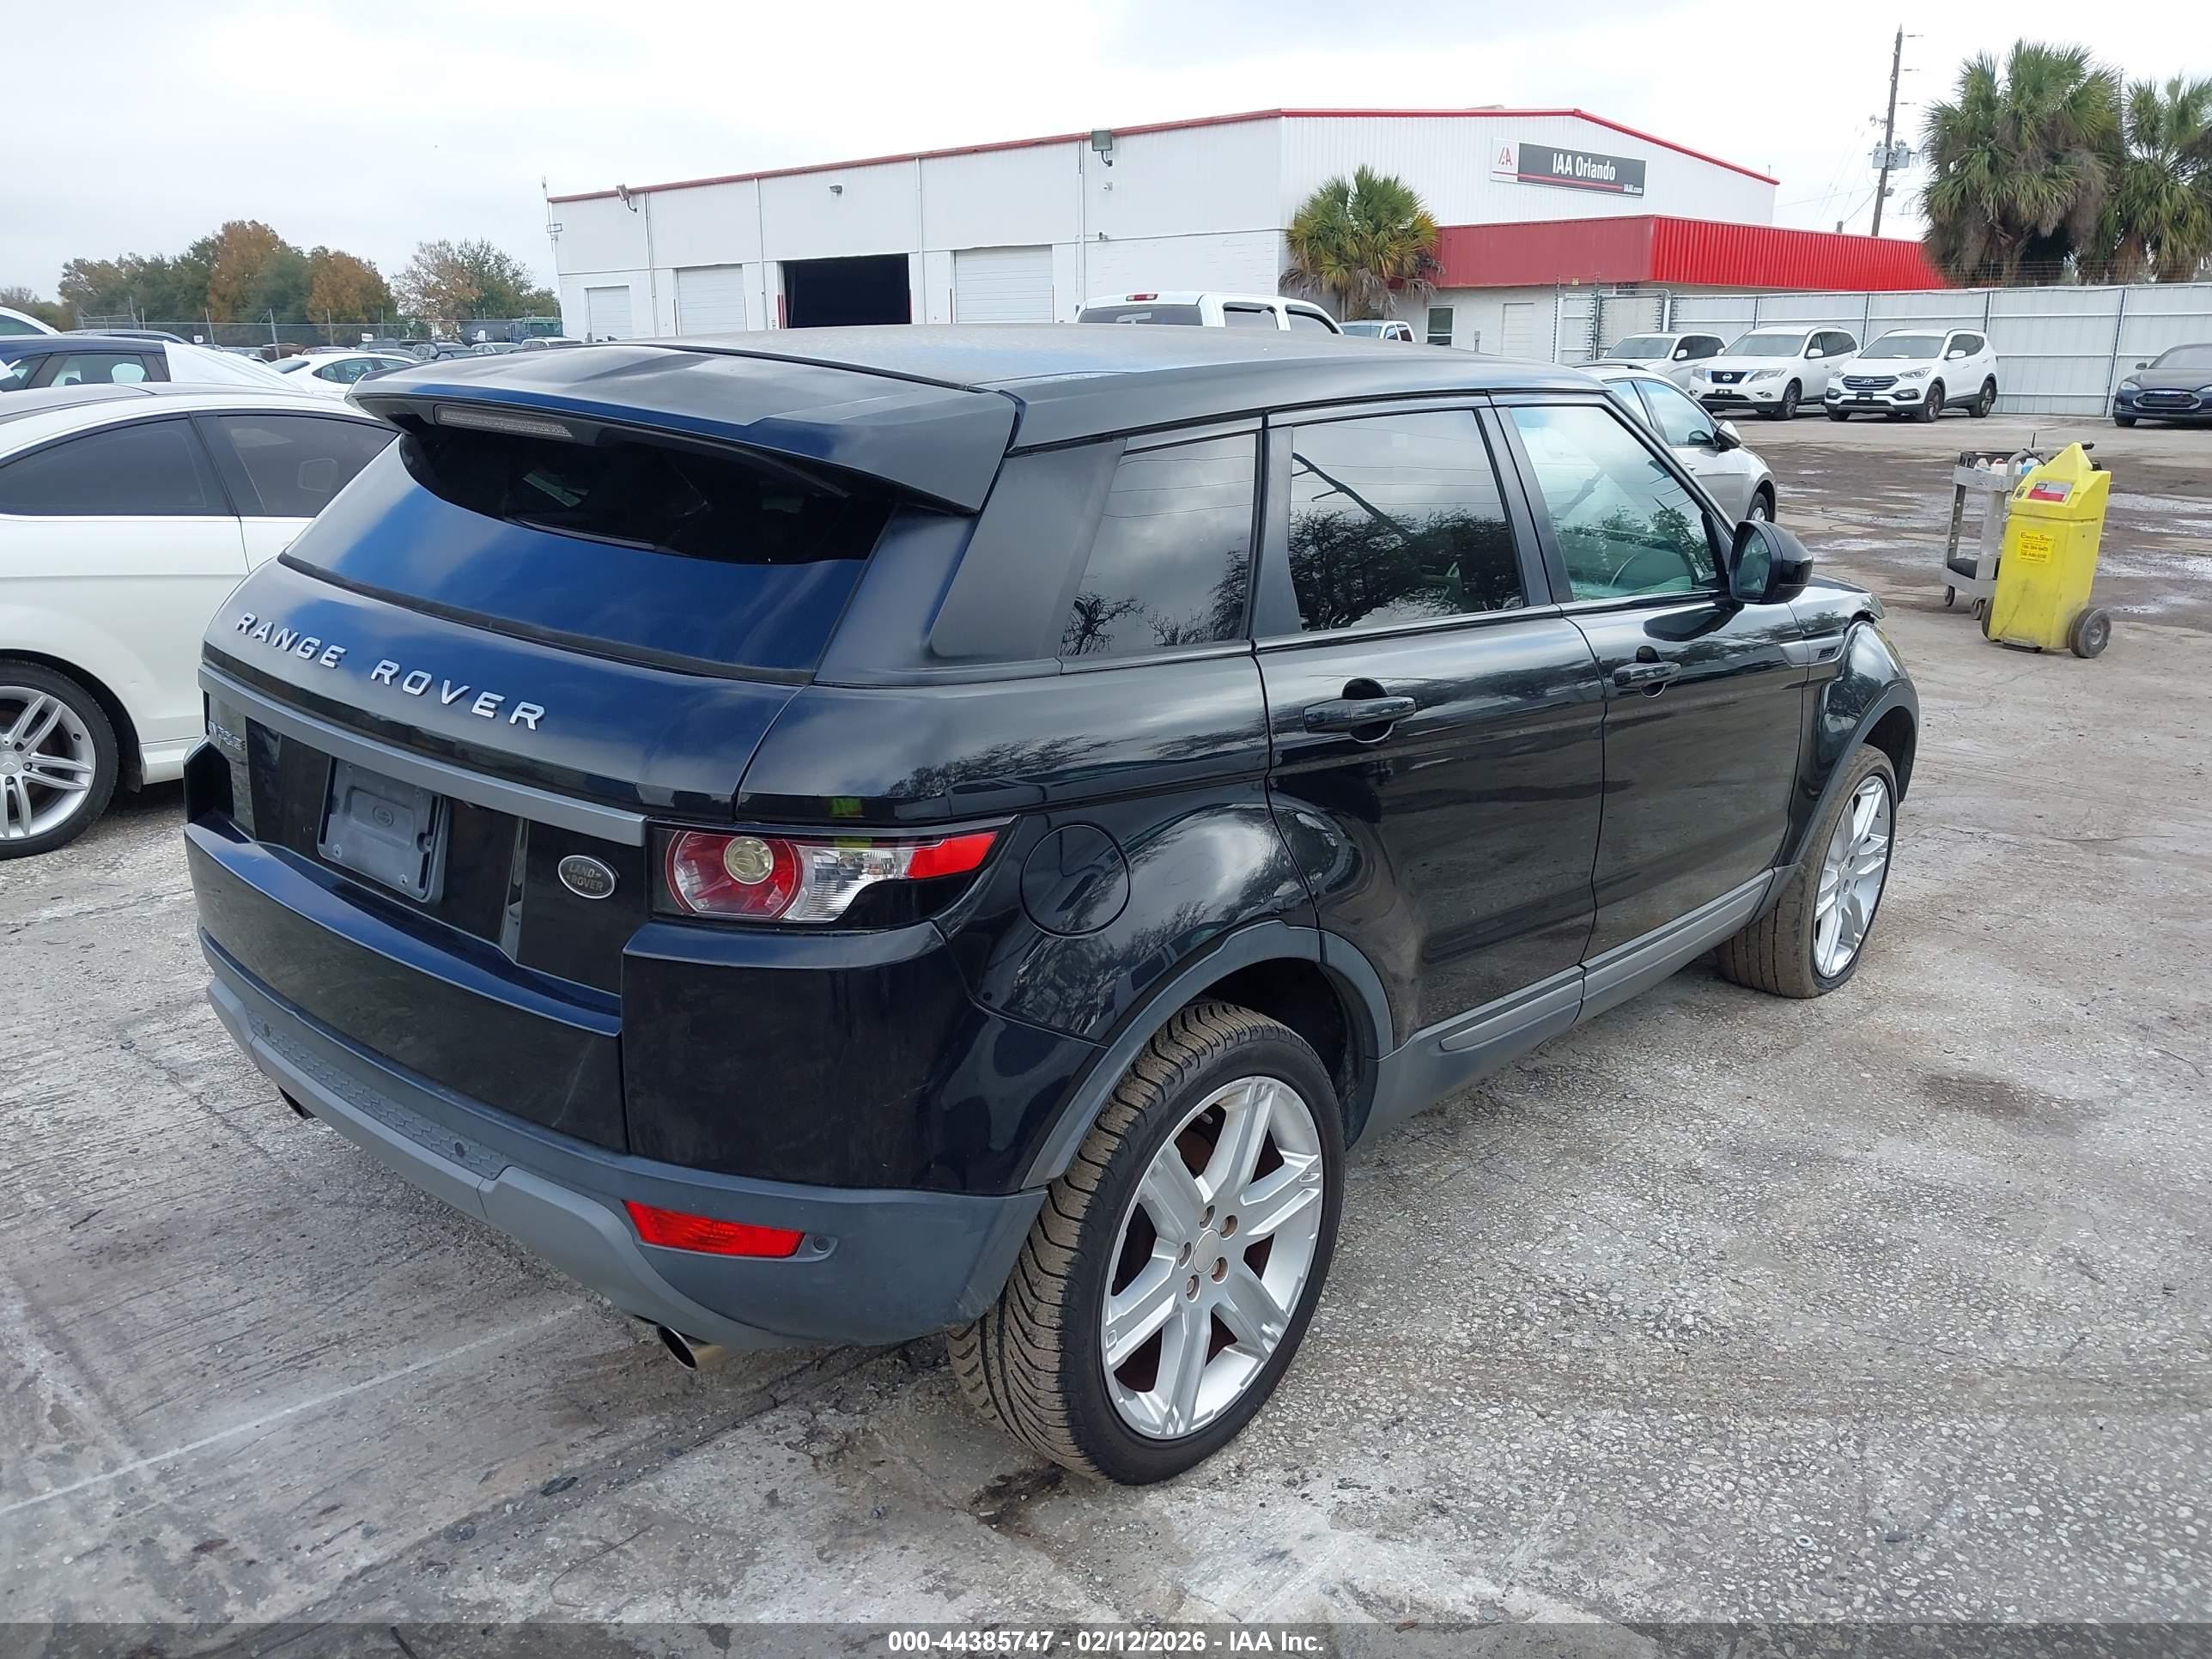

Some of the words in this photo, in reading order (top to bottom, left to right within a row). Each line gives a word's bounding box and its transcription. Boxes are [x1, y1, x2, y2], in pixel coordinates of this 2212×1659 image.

[1553, 152, 1573, 176] IAA
[1575, 155, 1616, 181] Orlando
[235, 611, 348, 669] RANGE
[370, 659, 546, 731] ROVER
[570, 874, 605, 891] ROVER
